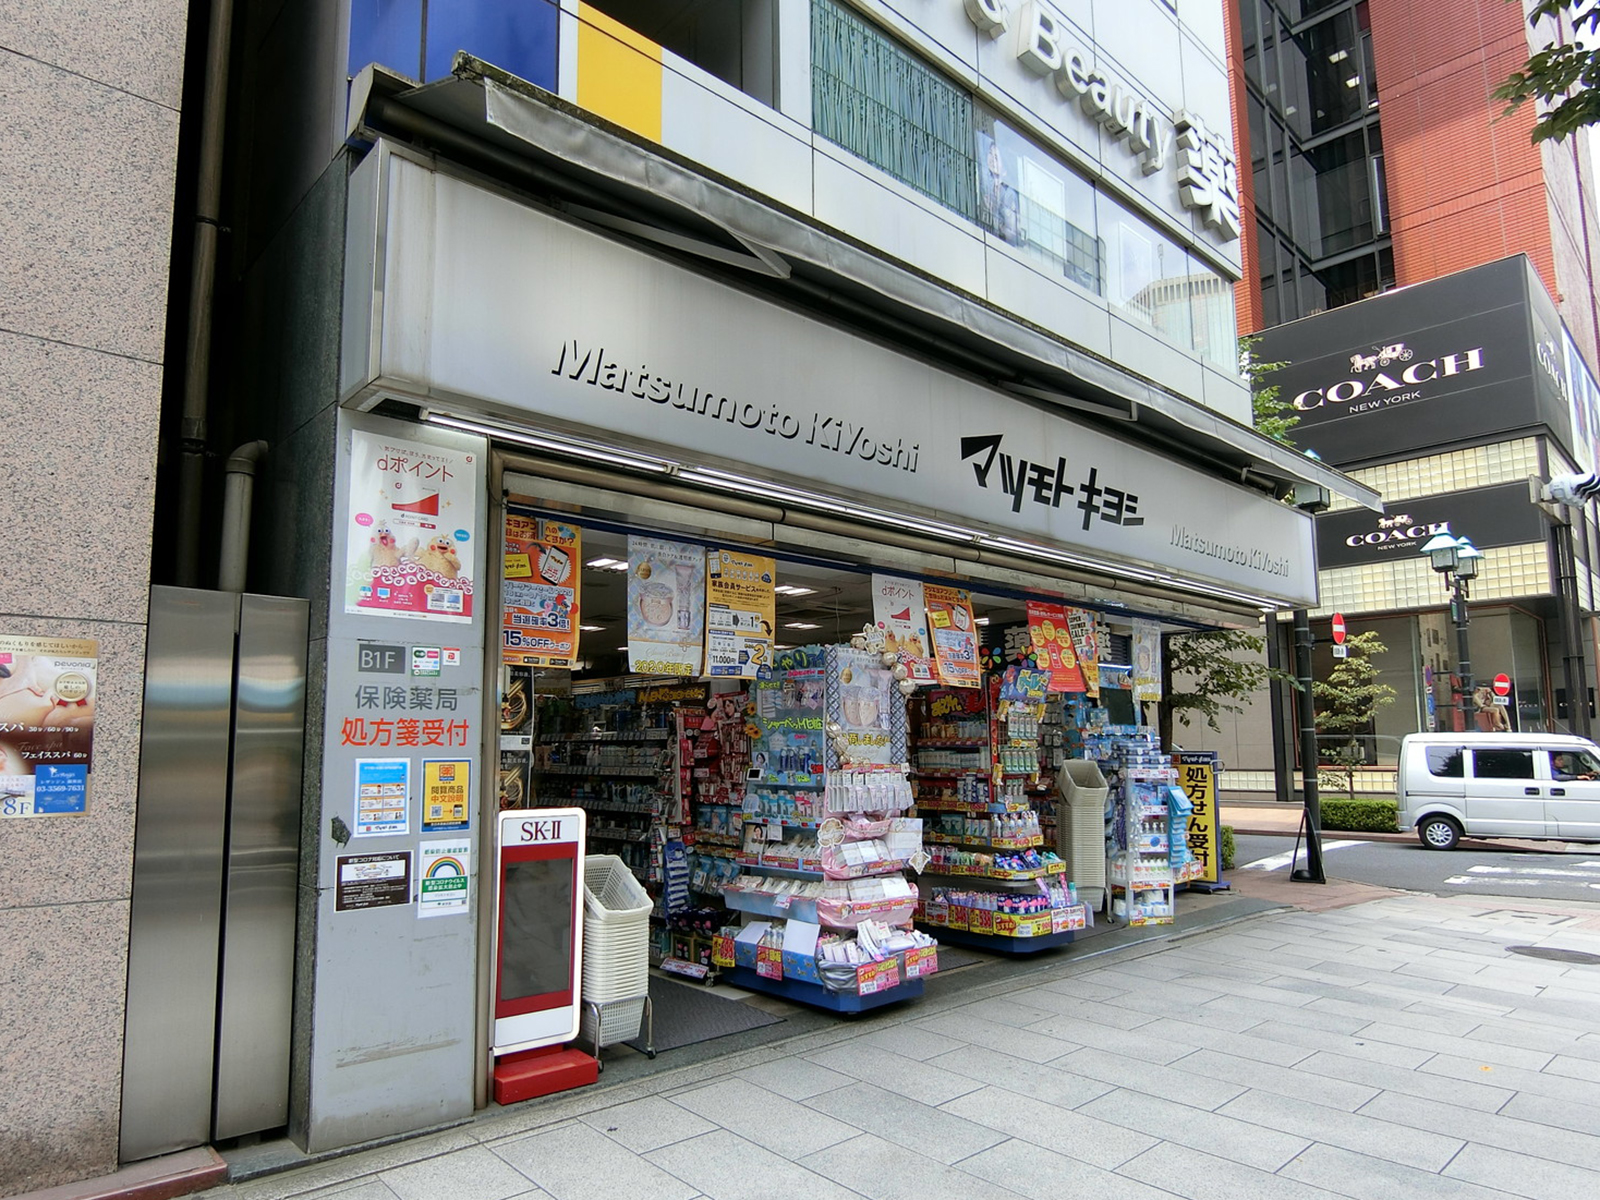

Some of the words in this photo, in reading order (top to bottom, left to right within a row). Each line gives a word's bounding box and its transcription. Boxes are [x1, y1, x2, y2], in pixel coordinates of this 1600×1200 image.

[1018, 2, 1172, 176] Beauty
[551, 339, 801, 440] Matsumoto
[1293, 347, 1485, 412] COACH
[1349, 399, 1381, 414] NEW
[1383, 390, 1421, 406] YORK
[377, 454, 453, 482] dポイント
[1345, 521, 1450, 547] COACH
[1377, 543, 1395, 551] NEW
[1396, 540, 1417, 549] YORK
[881, 586, 914, 600] dポイント
[1071, 628, 1085, 639] SALE
[362, 650, 396, 669] B1F
[634, 659, 693, 676] 2020年限定
[355, 685, 458, 711] 保険薬局
[341, 717, 469, 746] 処方箋受付
[21, 751, 71, 759] フェイススパ
[1186, 766, 1210, 867] 処方せん受付
[520, 820, 562, 841] SK-II
